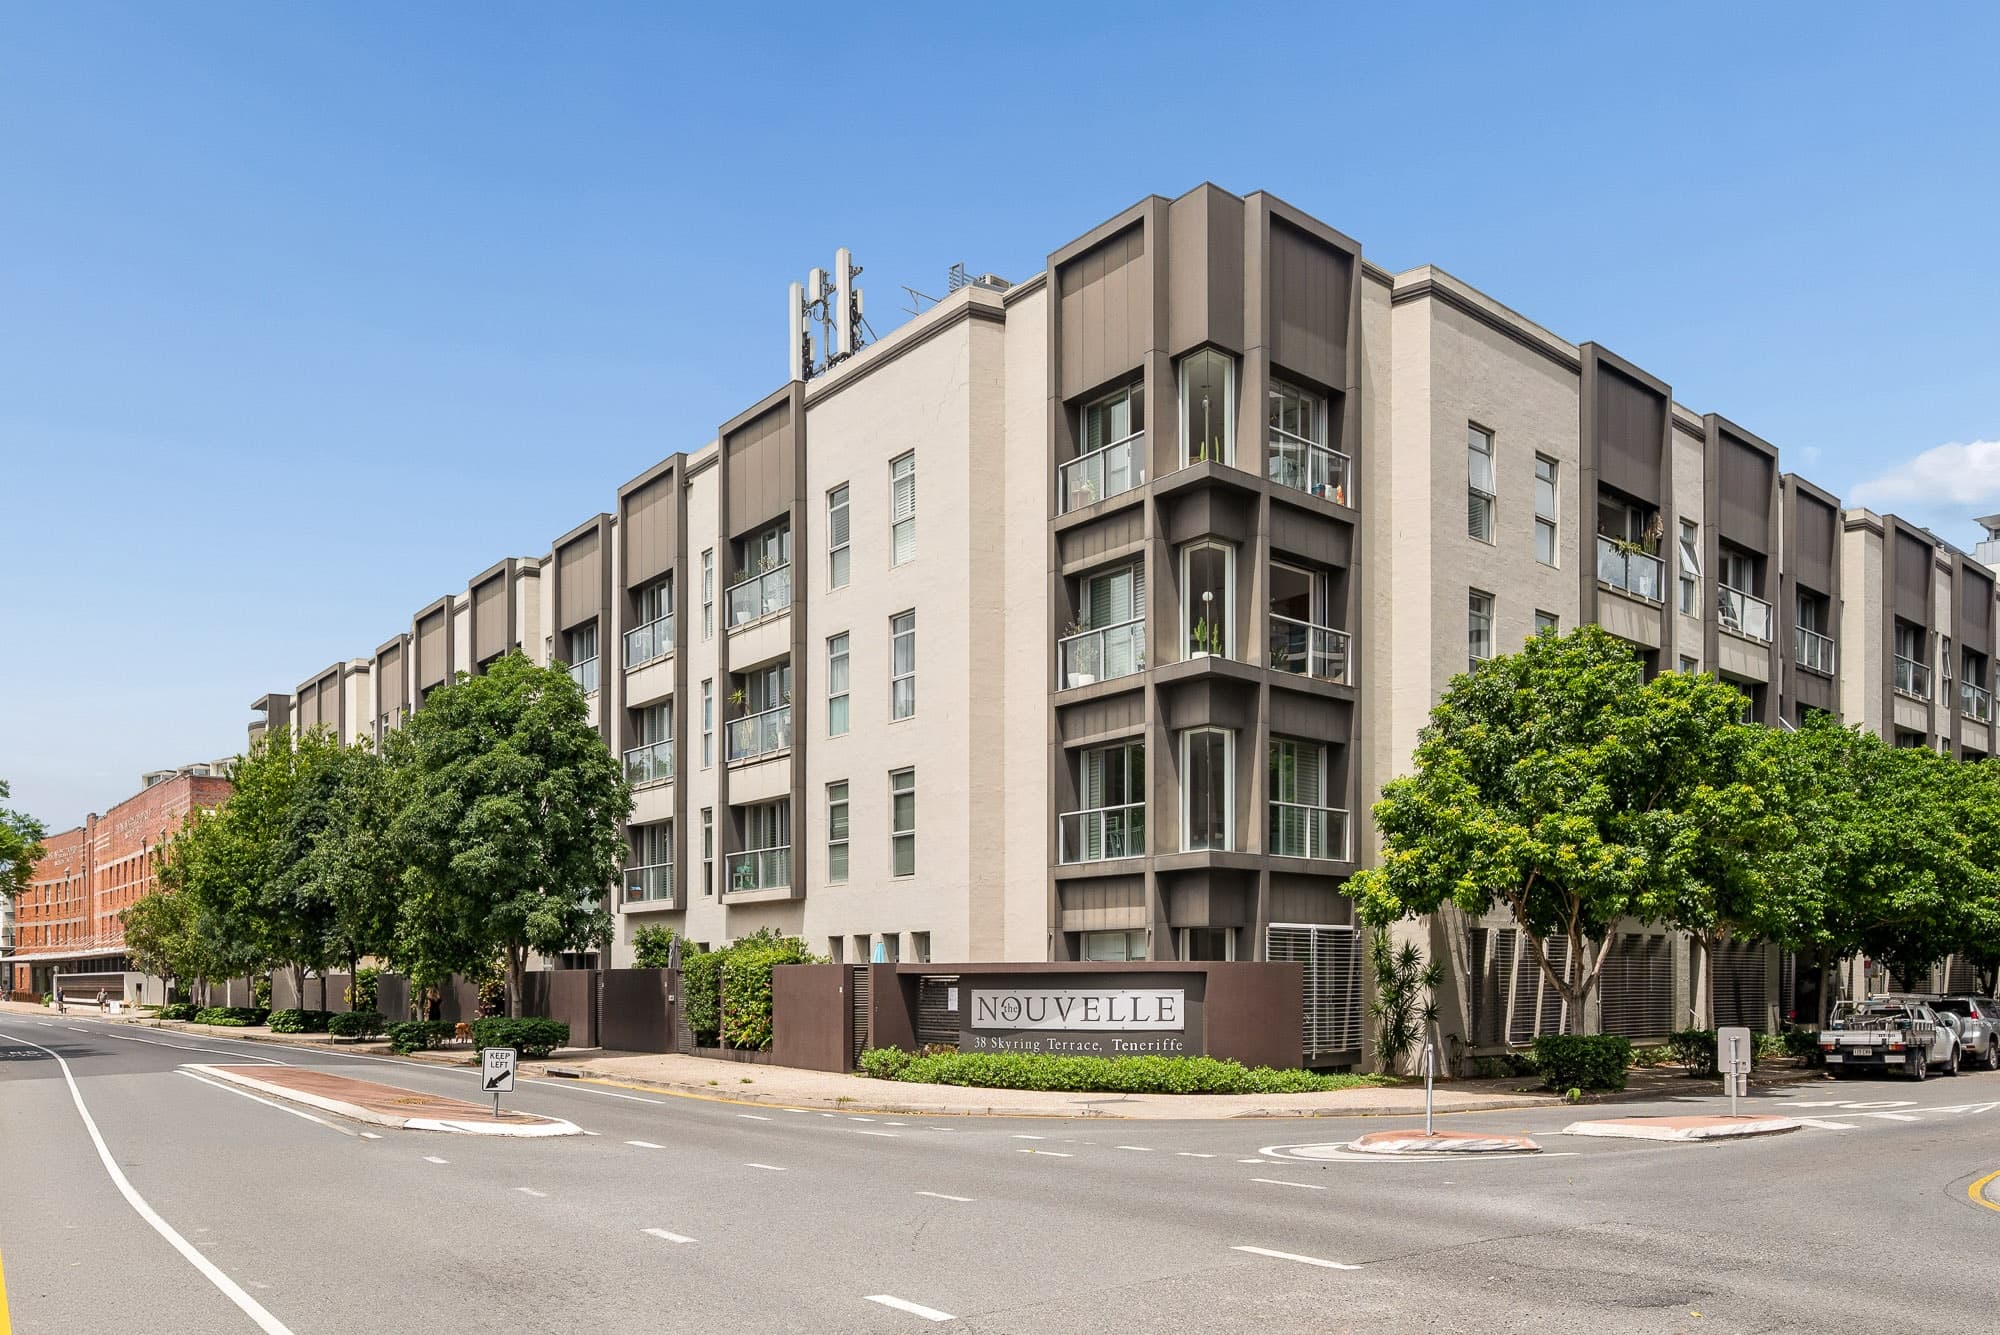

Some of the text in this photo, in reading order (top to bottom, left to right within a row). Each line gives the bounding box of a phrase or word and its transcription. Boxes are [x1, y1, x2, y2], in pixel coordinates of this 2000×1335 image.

[978, 996, 1176, 1022] NOUVELLE
[1004, 1003, 1018, 1013] the
[974, 1036, 1183, 1052] 38 Skyring Terrace, Teneriffe
[489, 1052, 510, 1060] KEEP
[490, 1061, 508, 1069] LEFT
